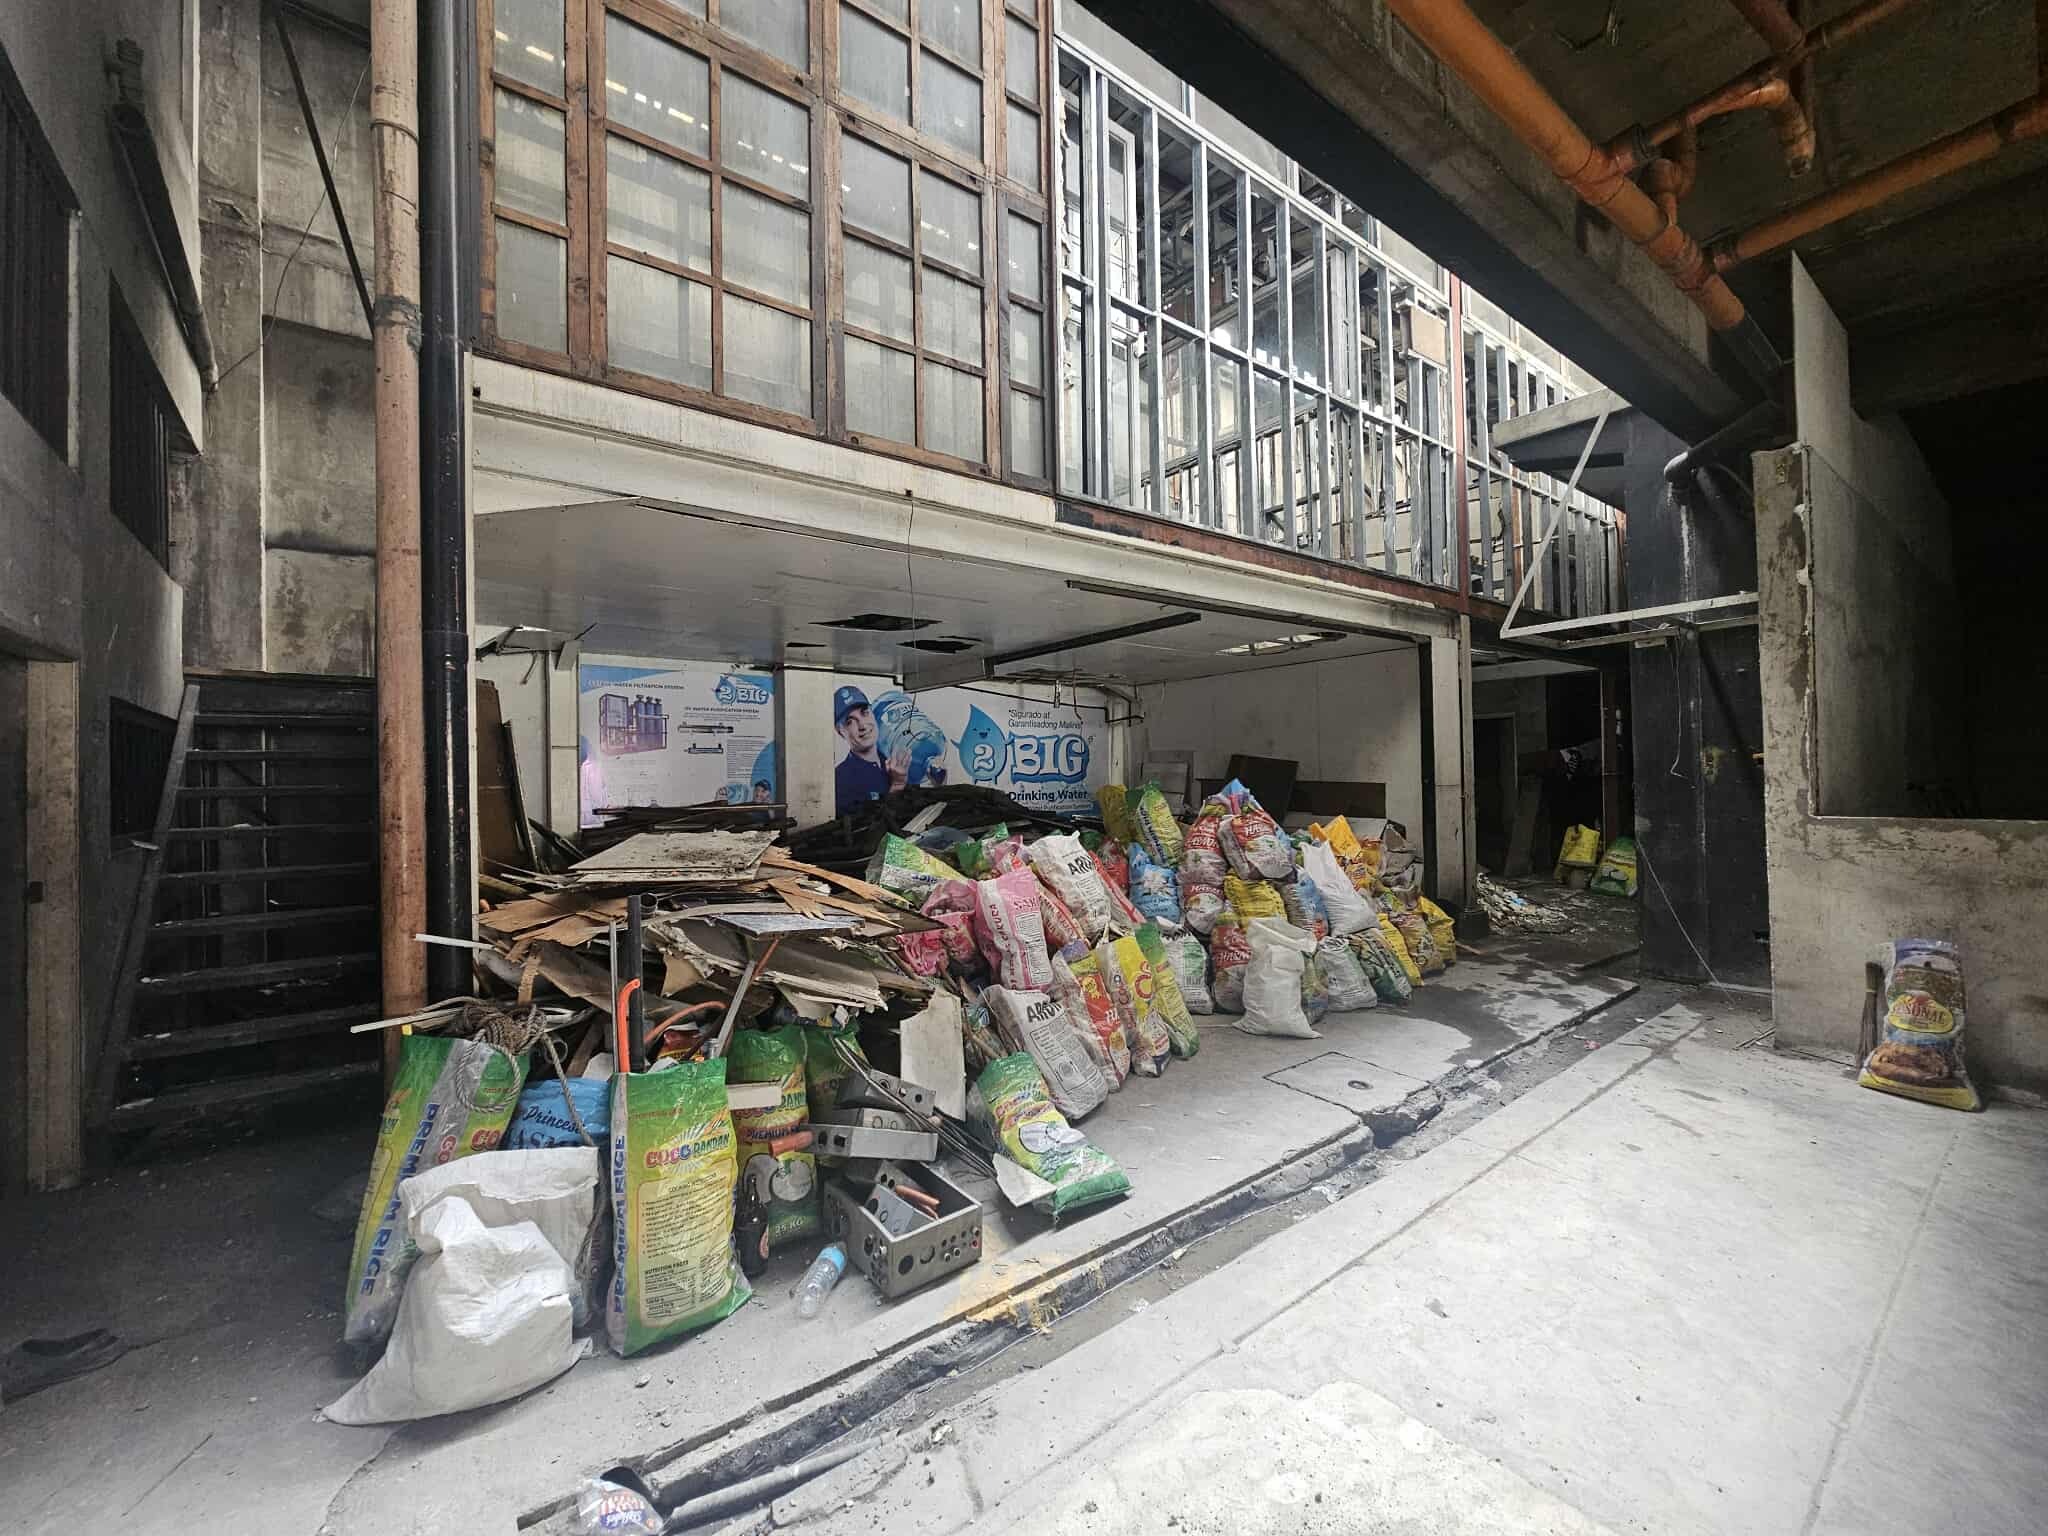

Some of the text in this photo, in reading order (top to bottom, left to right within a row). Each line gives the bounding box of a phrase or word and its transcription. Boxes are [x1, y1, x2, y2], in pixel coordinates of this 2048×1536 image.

[736, 688, 768, 702] BIG
[973, 735, 1087, 780] 2 BIG
[1008, 789, 1088, 802] Drinking Water
[614, 1134, 625, 1194] RICE
[361, 1228, 393, 1296] RICE
